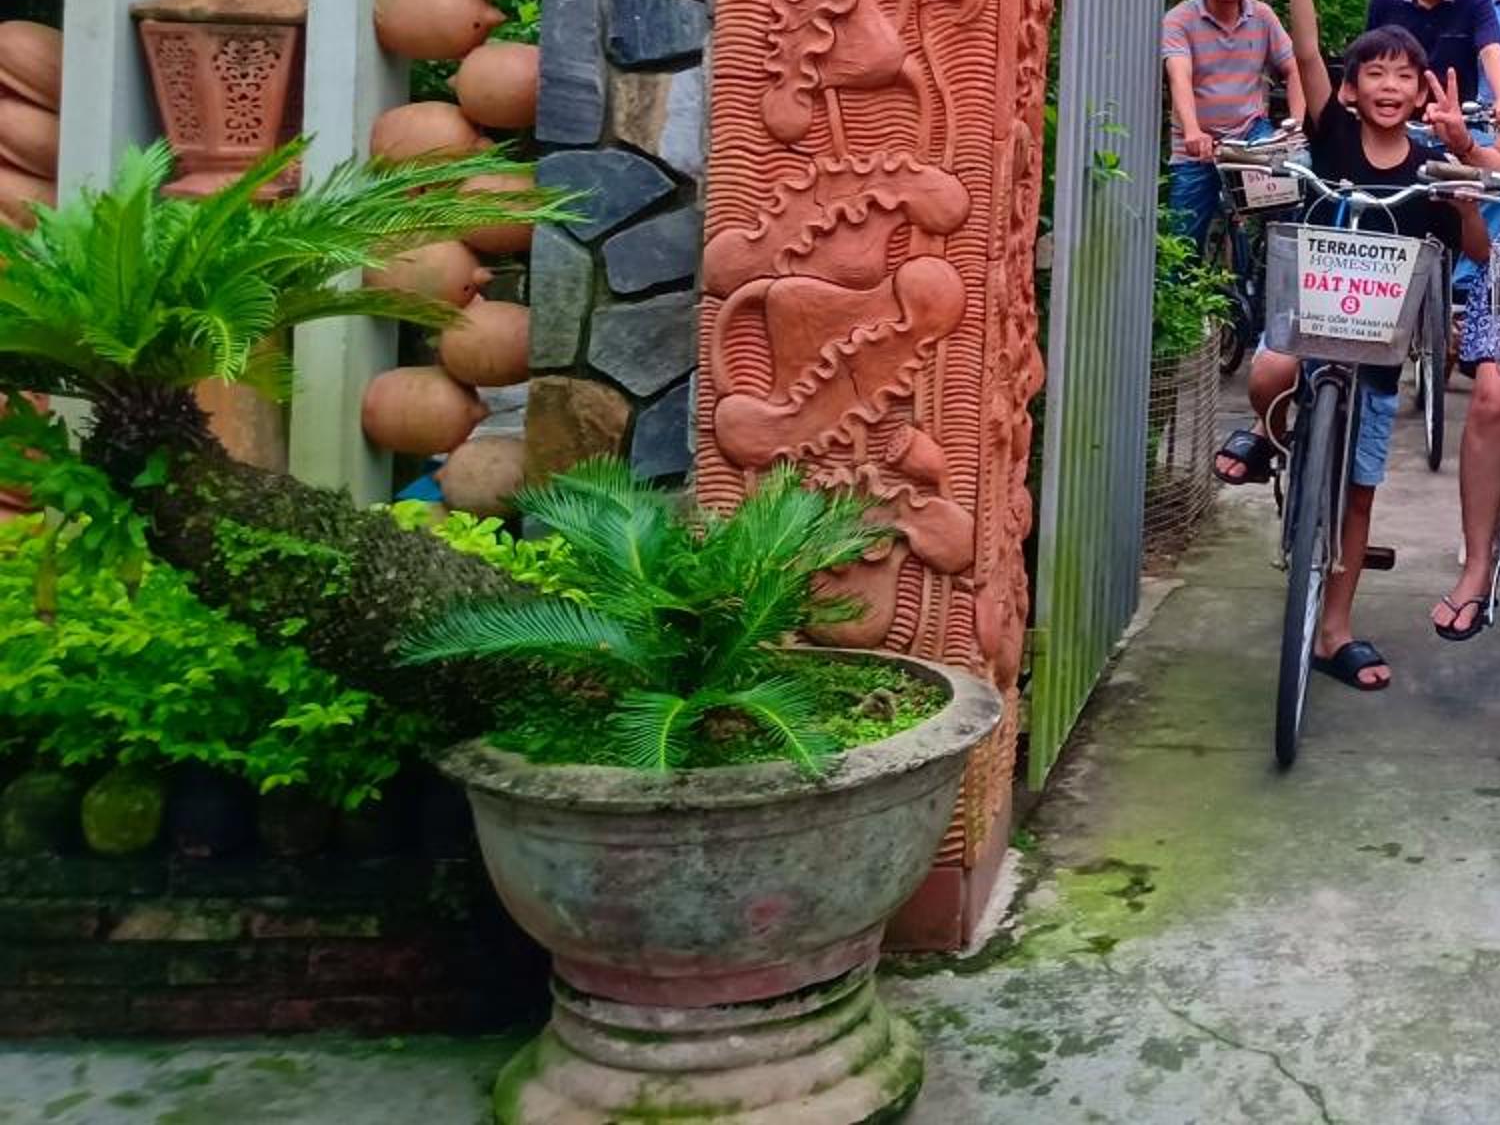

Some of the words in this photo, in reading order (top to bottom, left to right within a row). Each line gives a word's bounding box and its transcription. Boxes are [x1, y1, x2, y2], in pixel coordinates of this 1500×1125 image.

[1308, 238, 1407, 261] TERRACOTTA
[1310, 255, 1401, 276] HOMESTAY
[1347, 278, 1404, 299] NUNG
